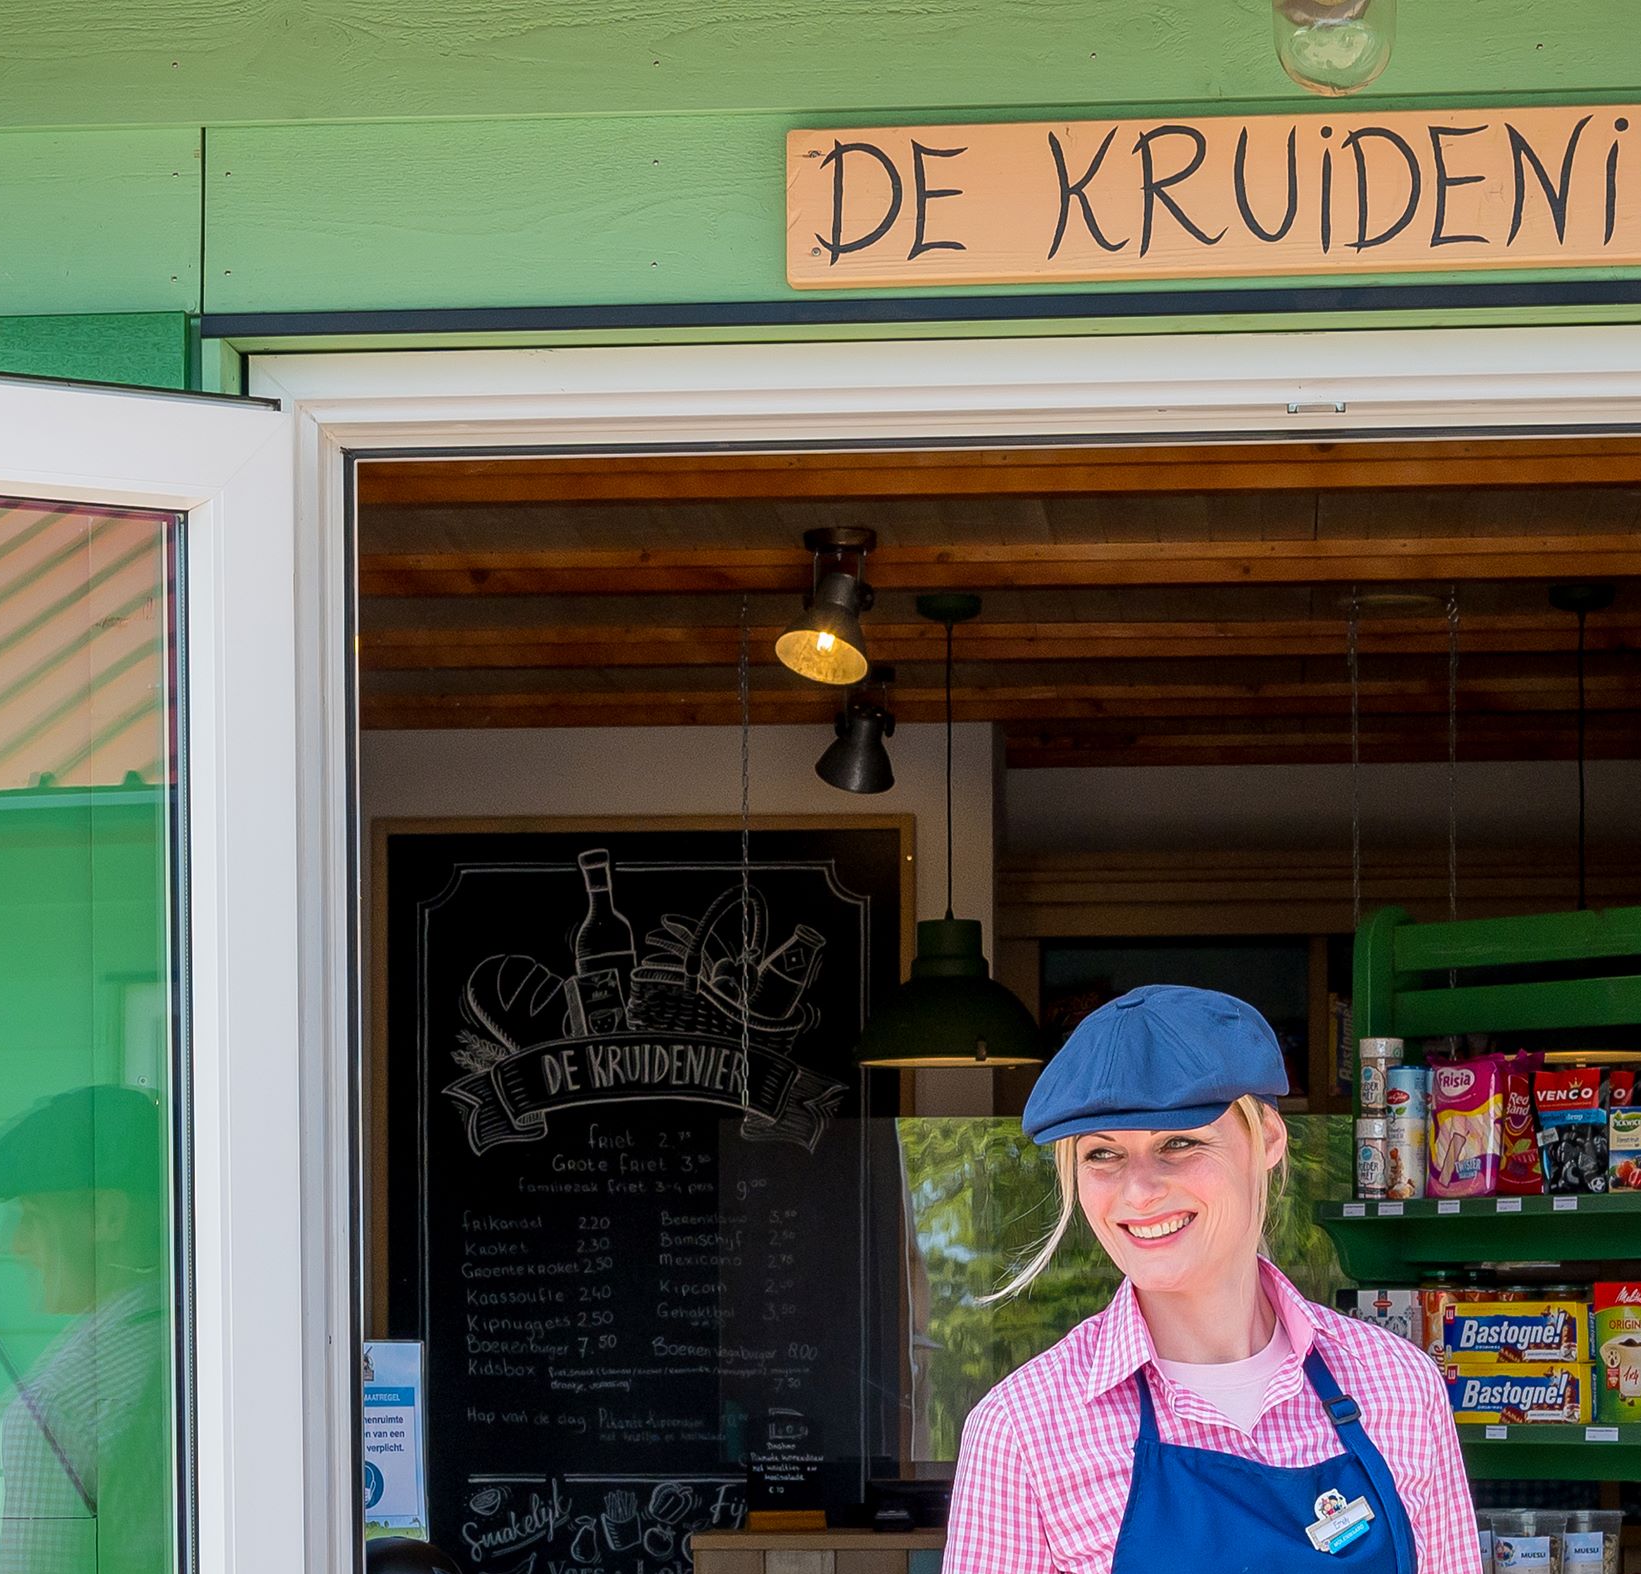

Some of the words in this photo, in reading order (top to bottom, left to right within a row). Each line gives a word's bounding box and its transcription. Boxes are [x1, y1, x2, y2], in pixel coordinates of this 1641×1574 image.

[816, 137, 969, 266] DE
[541, 1053, 581, 1097] DE
[587, 1043, 745, 1094] KRUIDENIER
[1438, 1070, 1471, 1088] Frisia
[1508, 1091, 1529, 1105] Red
[1536, 1087, 1594, 1102] VENCO
[1460, 1312, 1567, 1351] Bastogne!
[1462, 1373, 1569, 1411] Bastogne!
[366, 1443, 405, 1453] verplicht.
[460, 1478, 573, 1561] Smakelijk
[1574, 1546, 1599, 1555] MUESLI
